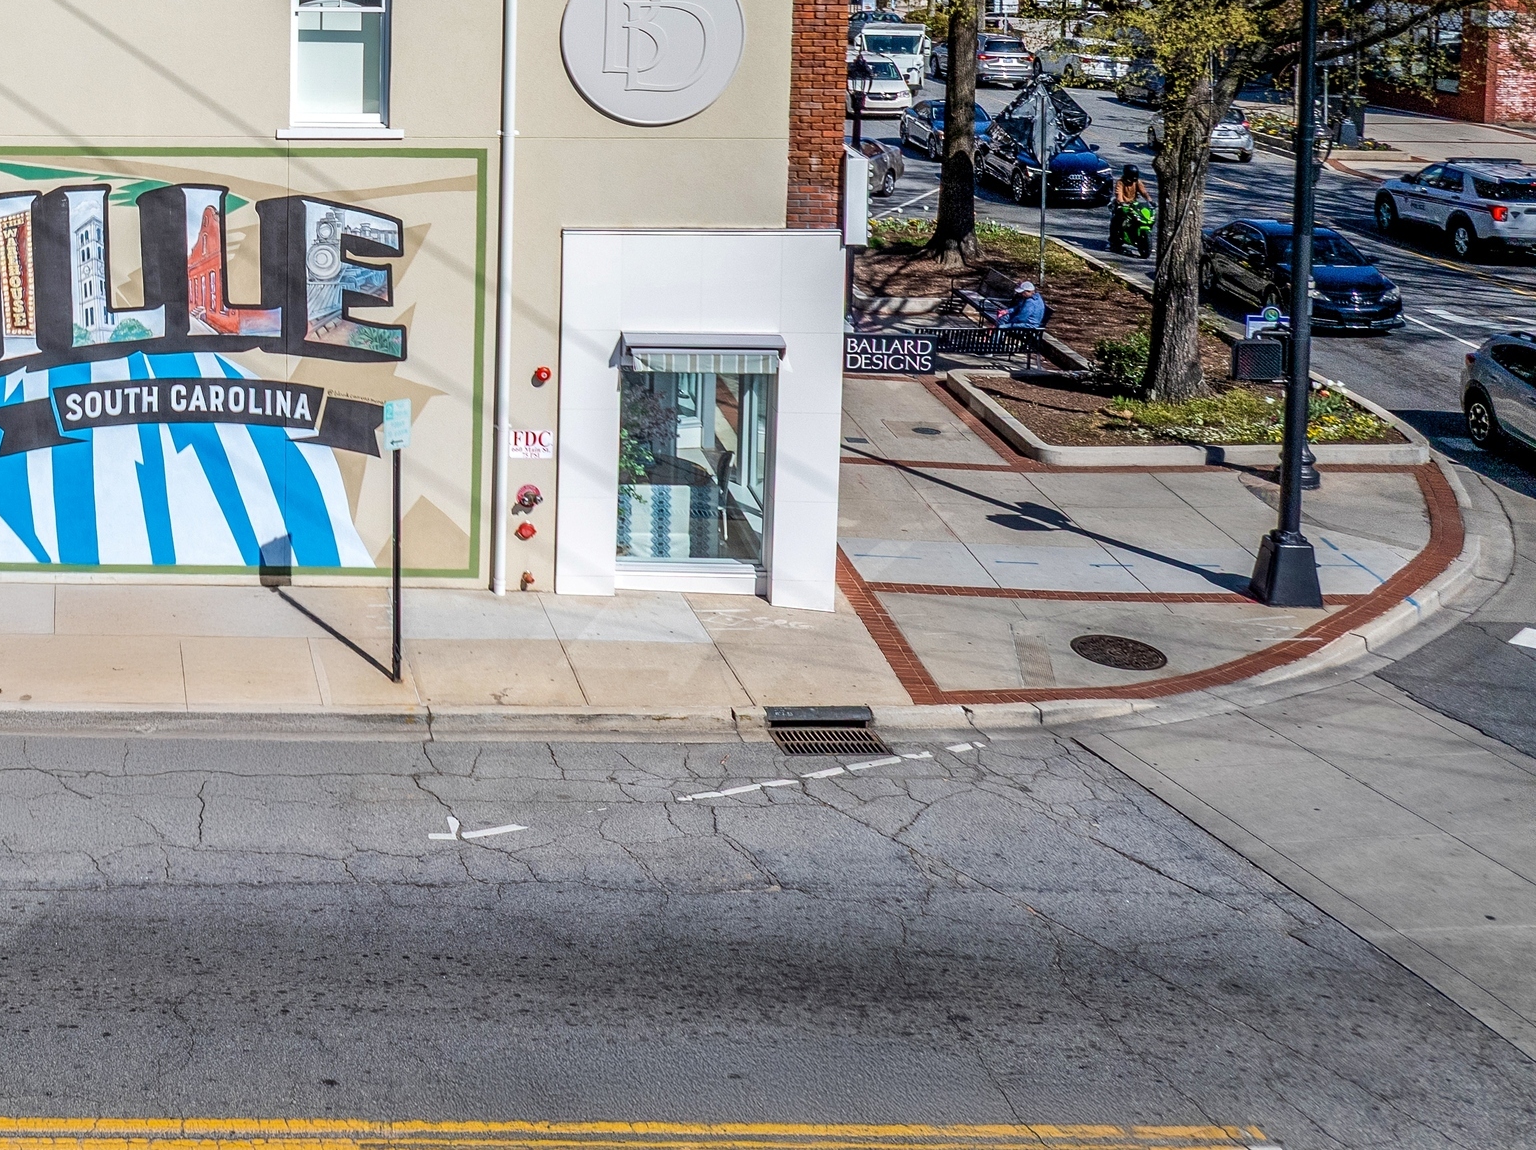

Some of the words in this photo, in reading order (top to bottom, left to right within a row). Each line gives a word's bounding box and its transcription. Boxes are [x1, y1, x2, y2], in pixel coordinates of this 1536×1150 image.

[847, 338, 932, 355] BALLARD
[846, 354, 932, 371] DESIGNS
[65, 386, 159, 421] SOUTH
[170, 384, 313, 421] CAROLINA
[512, 430, 552, 447] FDC
